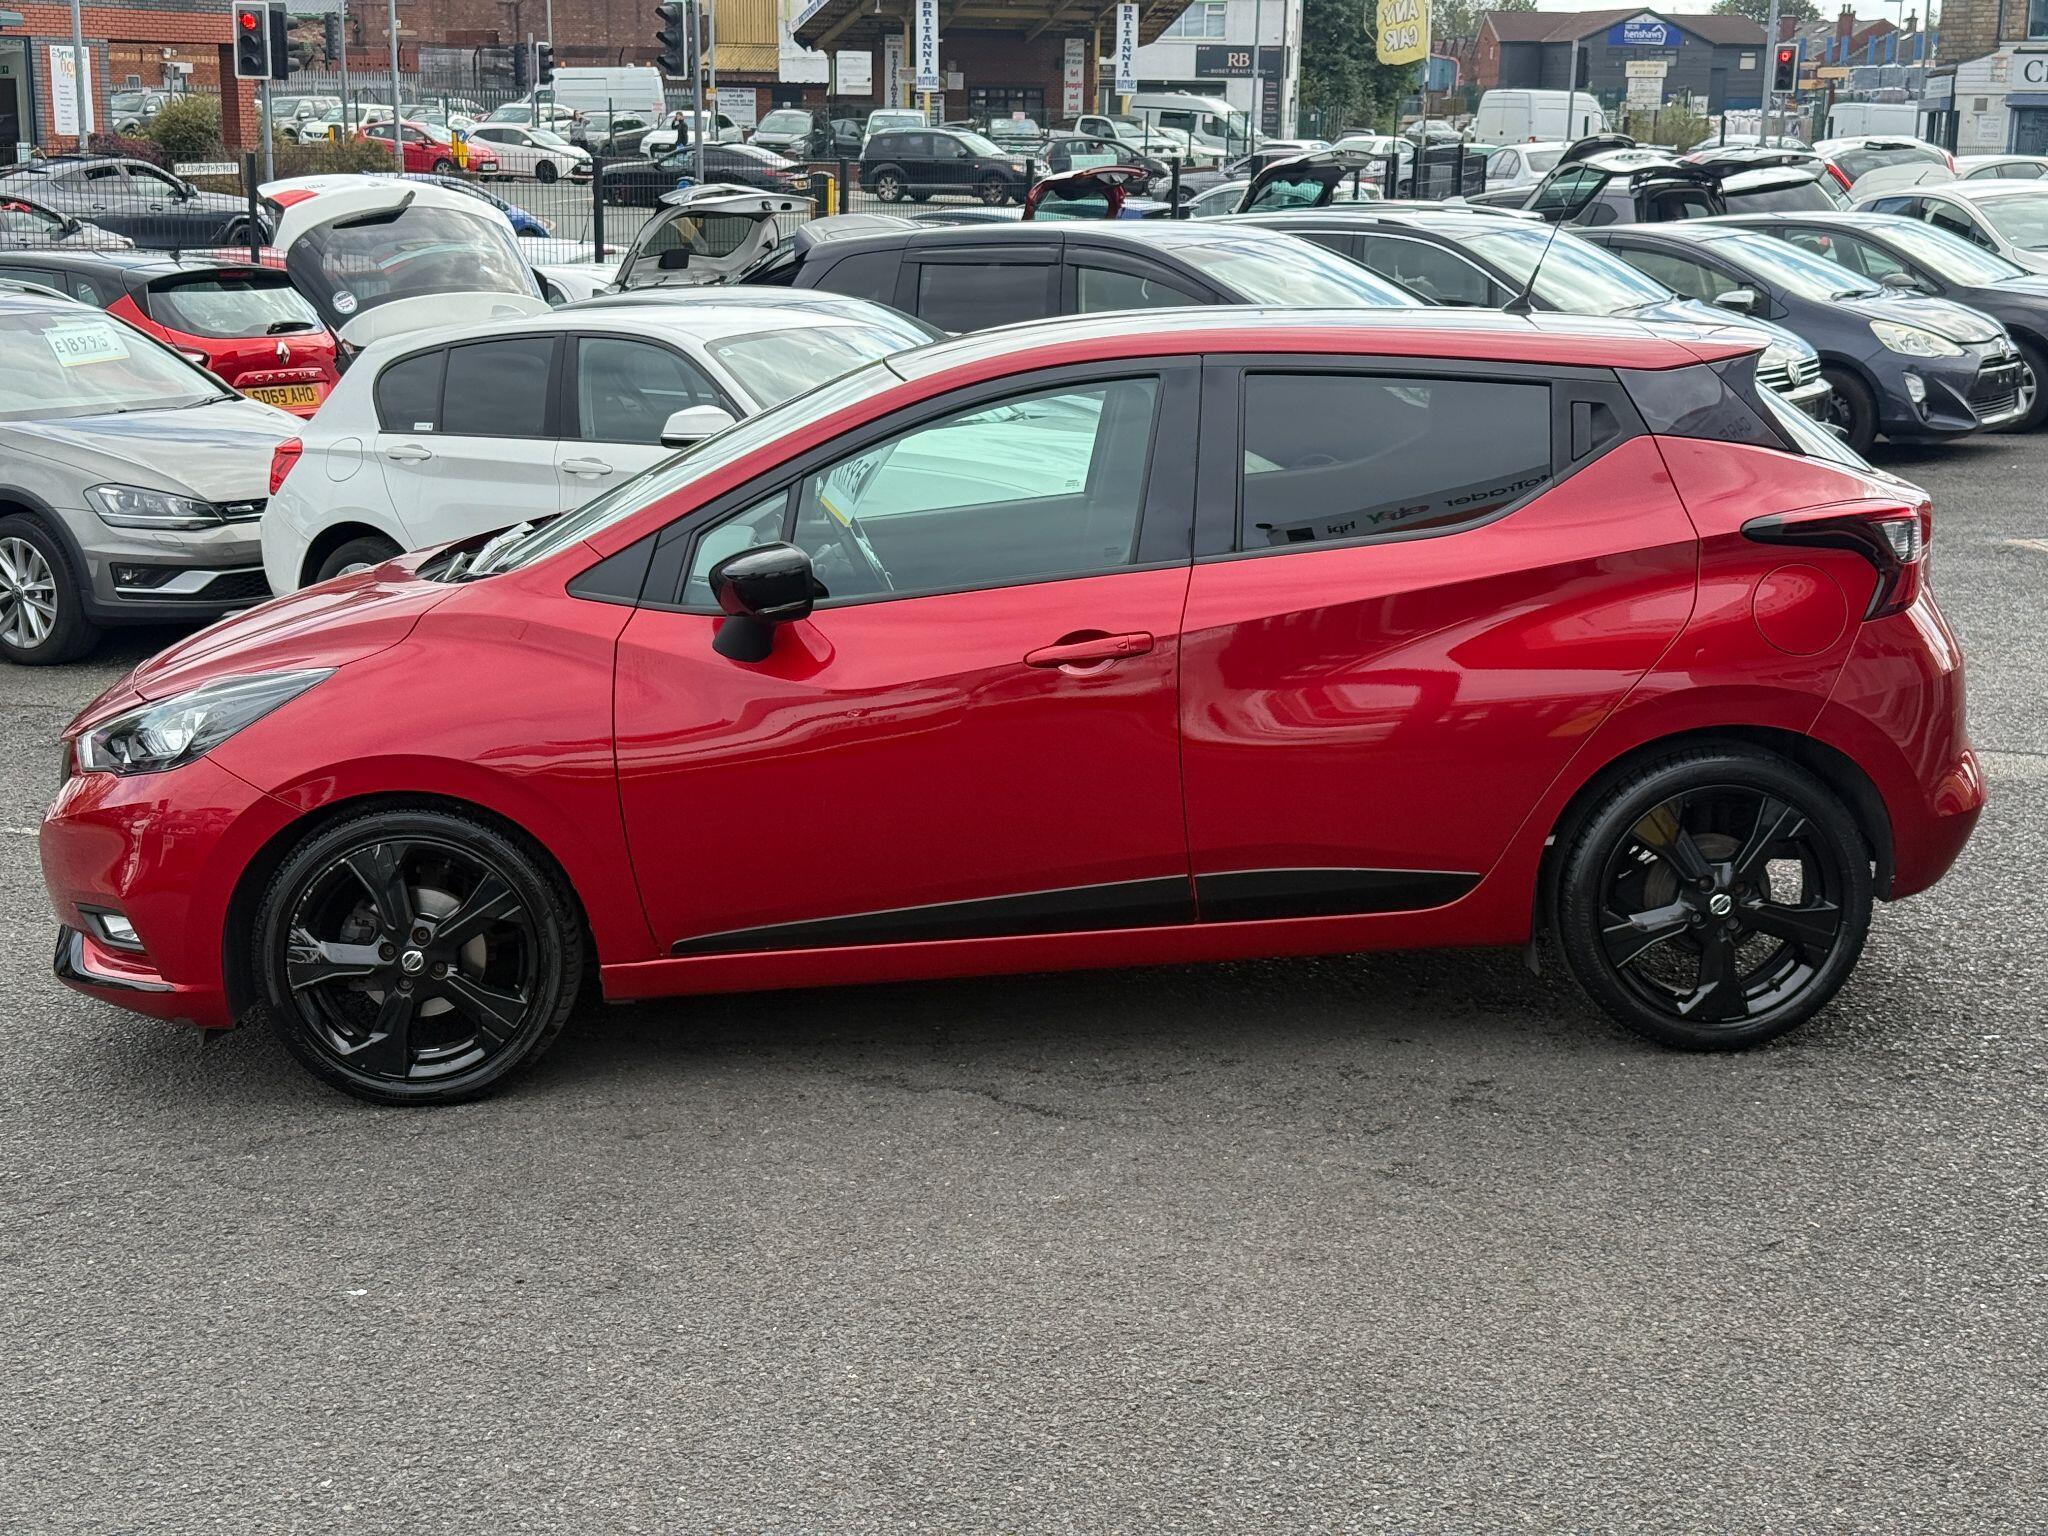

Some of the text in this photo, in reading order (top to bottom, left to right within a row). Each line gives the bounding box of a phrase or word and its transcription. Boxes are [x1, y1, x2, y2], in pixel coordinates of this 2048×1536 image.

[922, 2, 932, 74] BRITANNIA
[1122, 5, 1133, 77] BRITANNIA
[1624, 29, 1662, 38] henshaws
[1227, 52, 1250, 67] RB
[2023, 59, 2048, 83] C
[254, 370, 319, 382] CAPTUR
[252, 386, 315, 405] SD69 AHO
